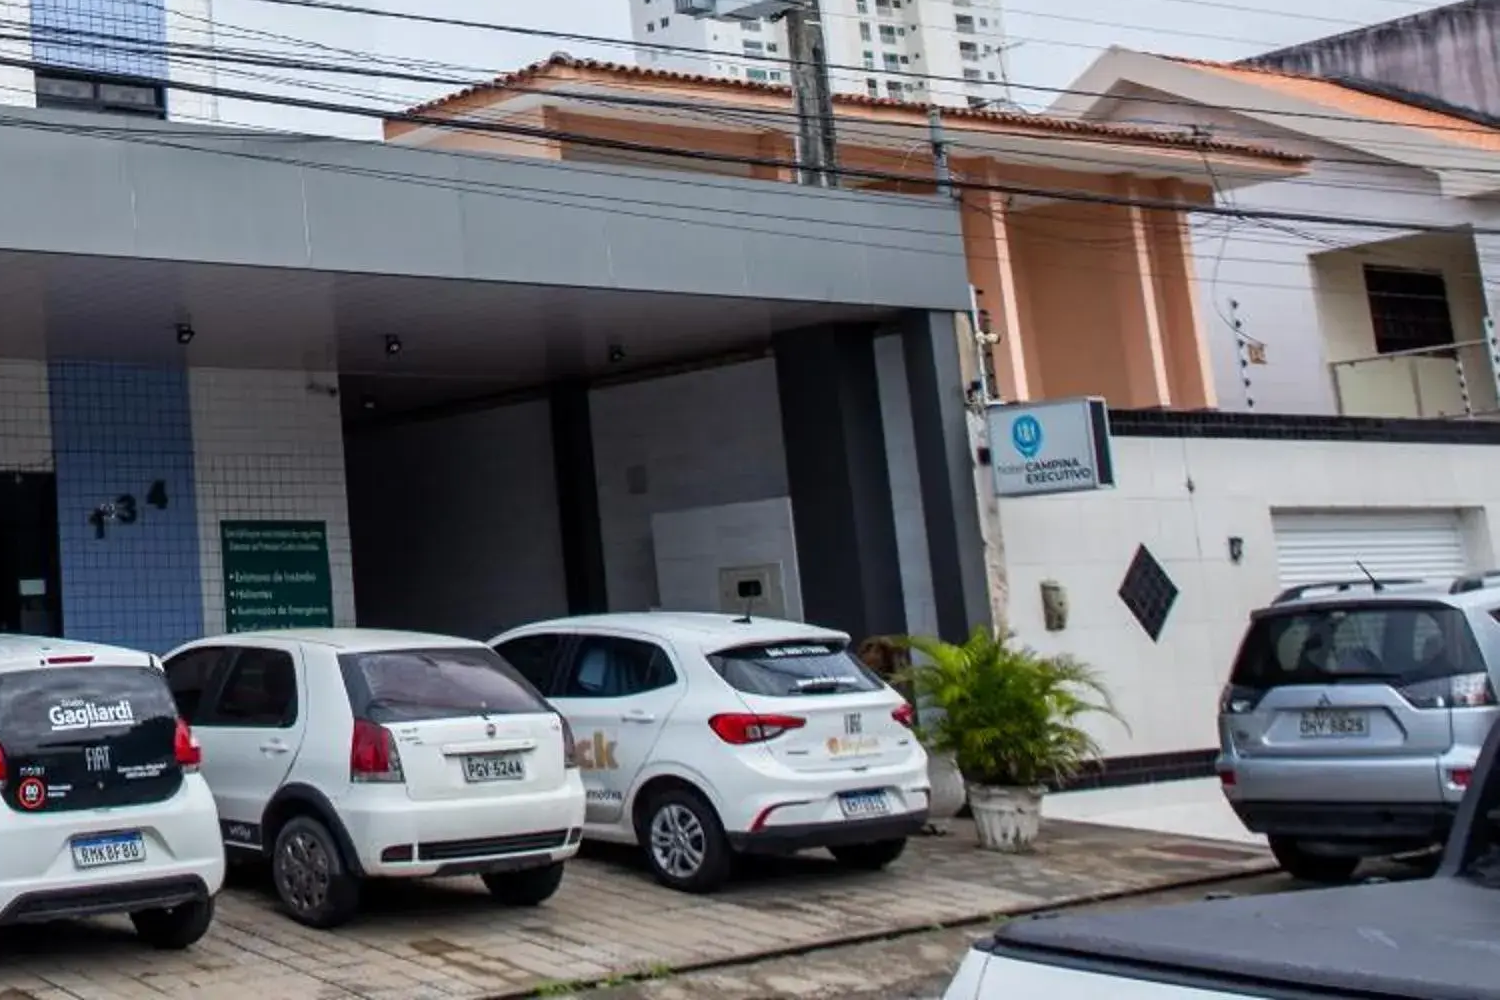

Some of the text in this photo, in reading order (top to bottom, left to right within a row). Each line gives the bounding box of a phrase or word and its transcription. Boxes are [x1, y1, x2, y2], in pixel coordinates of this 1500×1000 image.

[1025, 457, 1081, 473] CAMPINA
[1026, 467, 1091, 485] EXECUTIVO
[88, 479, 169, 540] 134
[49, 700, 133, 727] Gagliardi
[85, 745, 112, 771] FIAT
